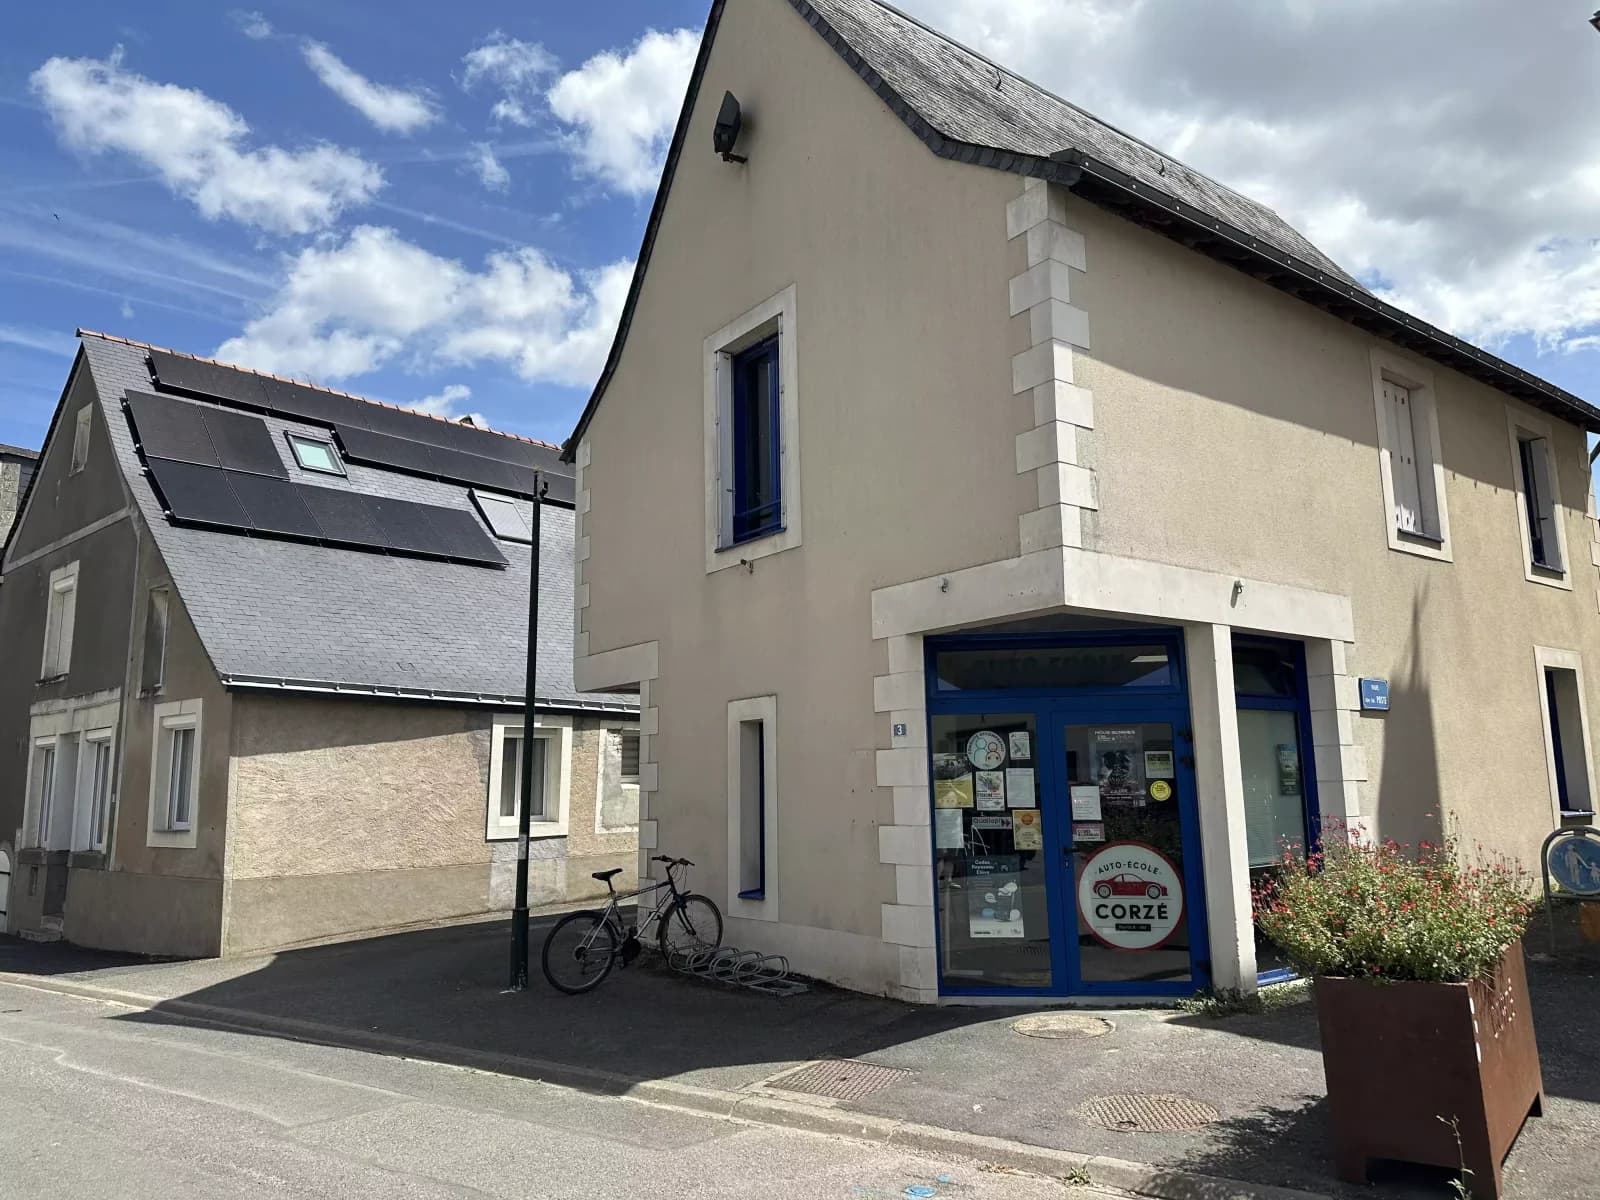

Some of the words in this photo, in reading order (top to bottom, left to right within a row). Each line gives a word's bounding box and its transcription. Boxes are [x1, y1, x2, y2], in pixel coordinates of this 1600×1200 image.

[896, 724, 903, 736] 3
[1098, 861, 1160, 875] AUTO-ÉCOLE
[1096, 902, 1169, 920] CORZÉ
